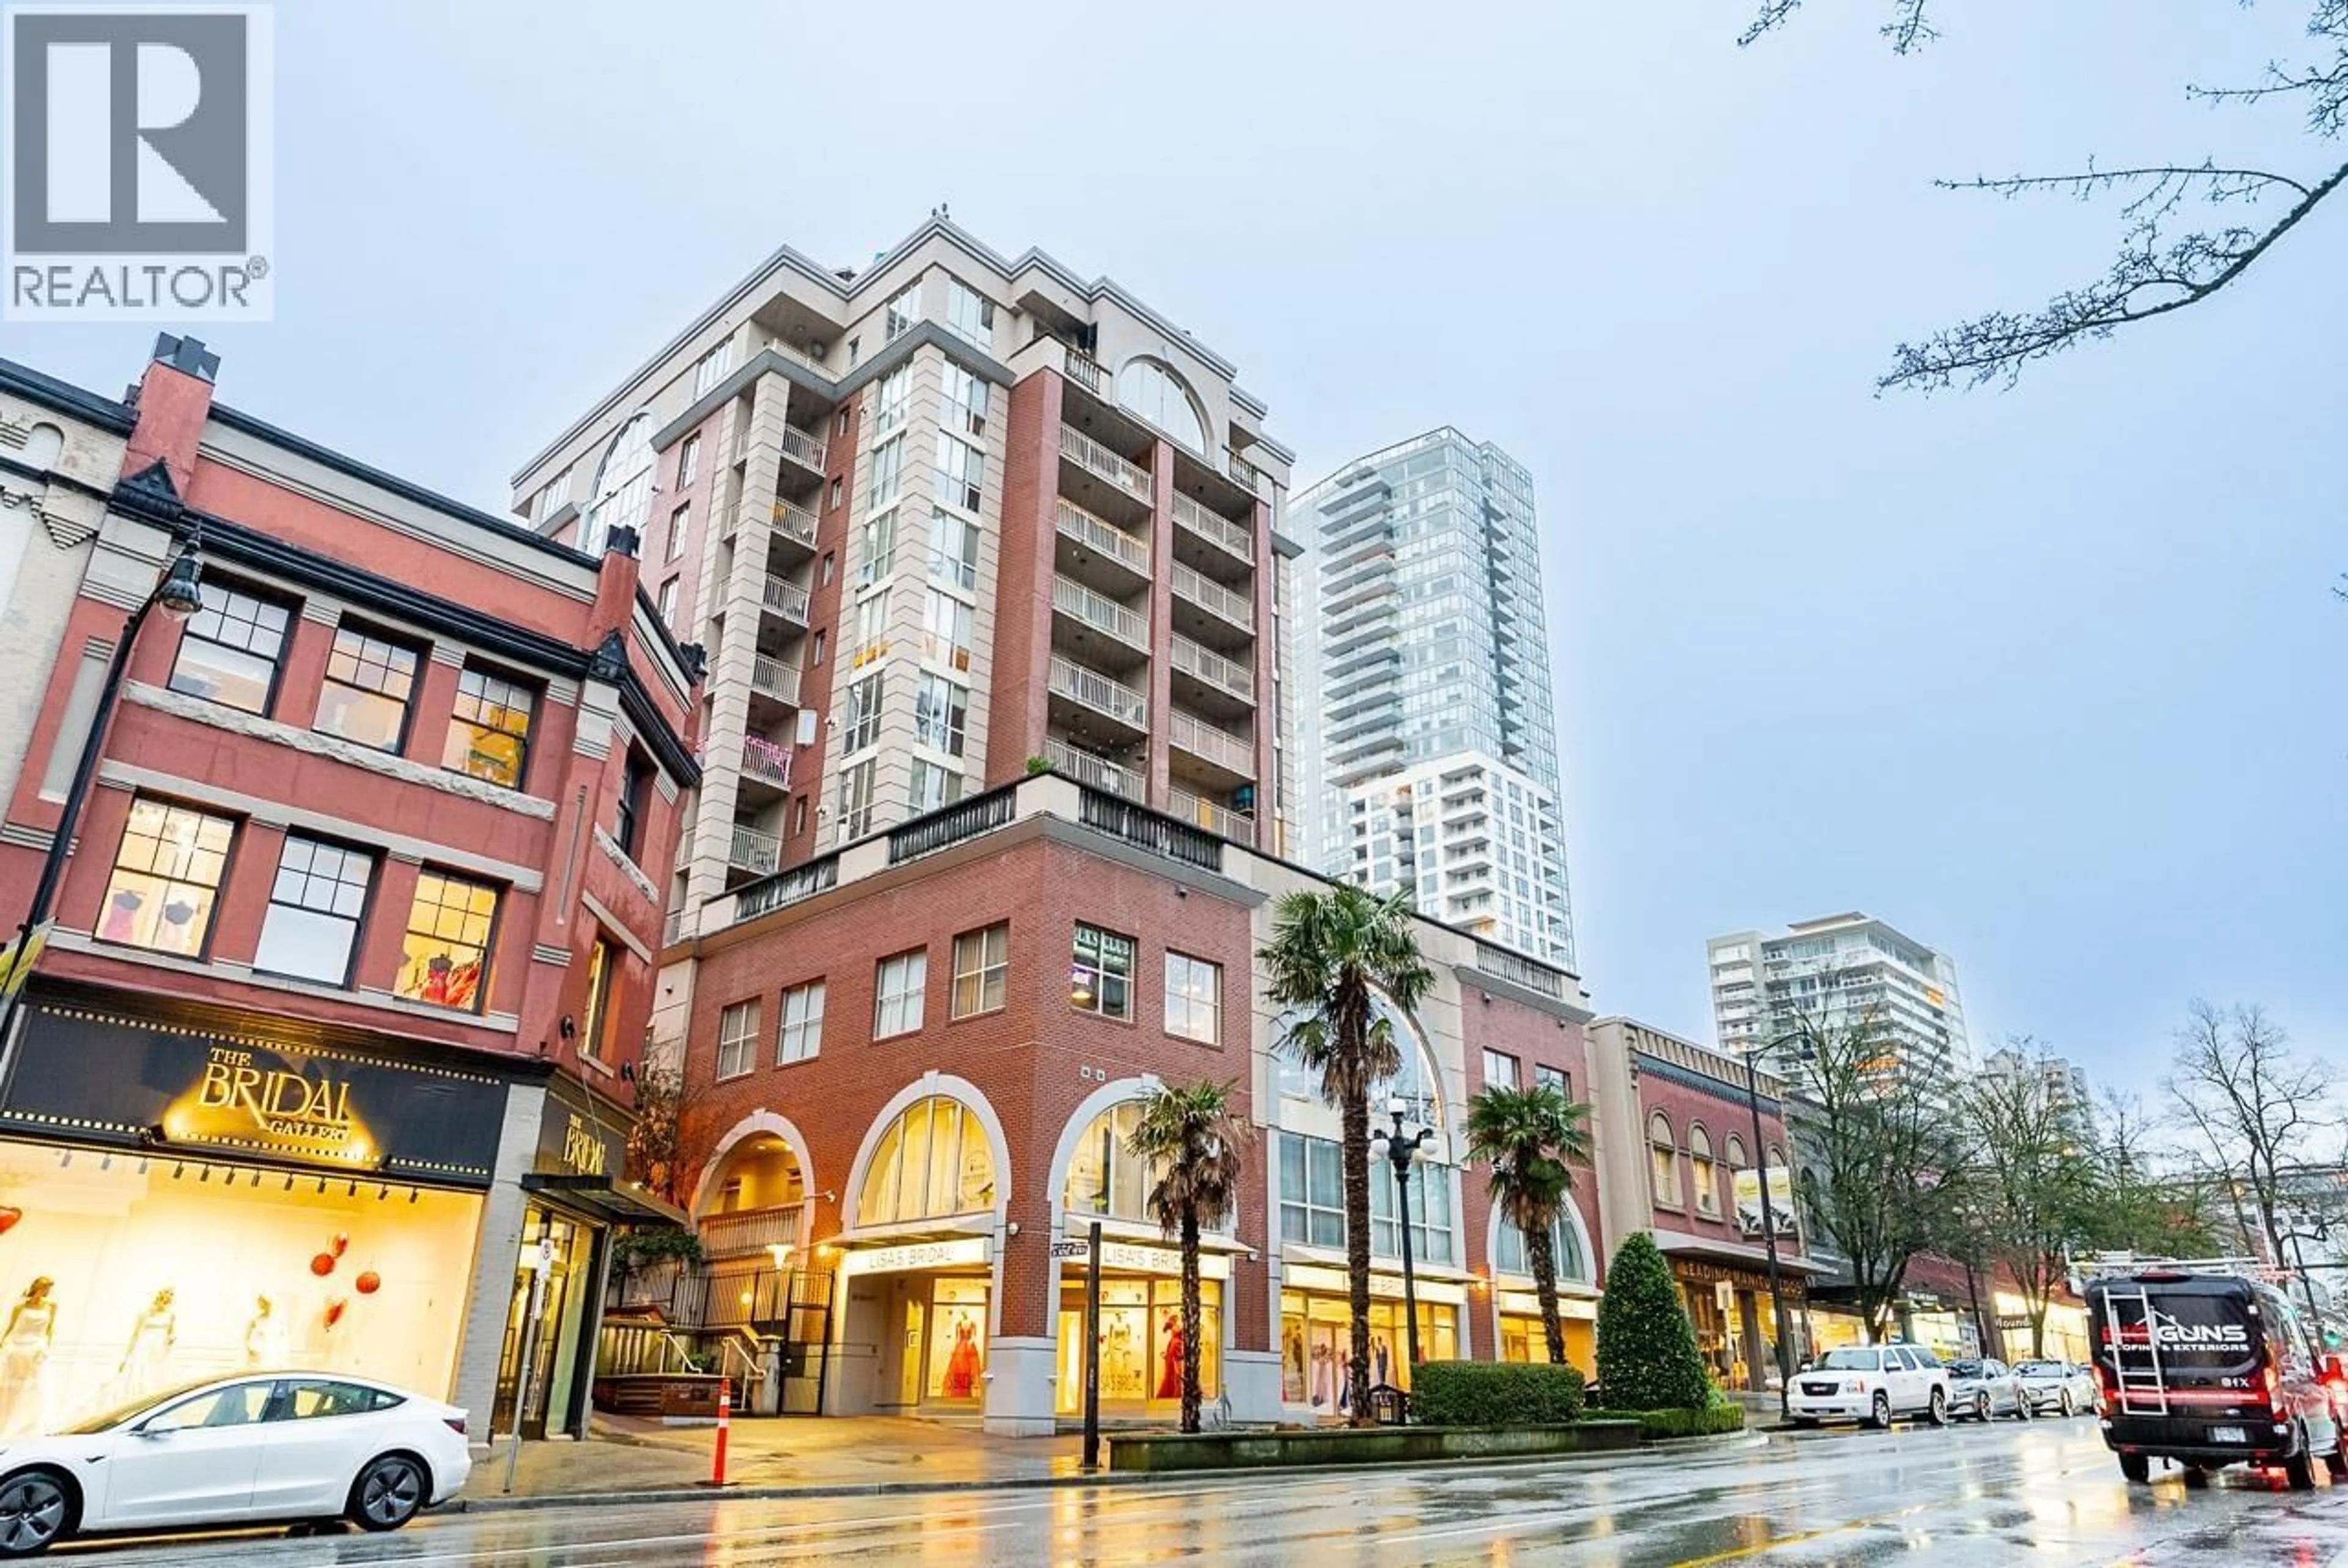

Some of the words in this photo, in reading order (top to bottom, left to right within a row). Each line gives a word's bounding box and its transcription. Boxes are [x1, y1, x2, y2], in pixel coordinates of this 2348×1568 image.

[210, 1047, 252, 1067] THE
[198, 1062, 350, 1130] BRIDAL
[909, 1246, 953, 1265] BRIDAL
[1104, 1247, 1146, 1266] LISA'S
[1151, 1252, 1181, 1270] BRID
[2158, 1325, 2247, 1342] GUNS
